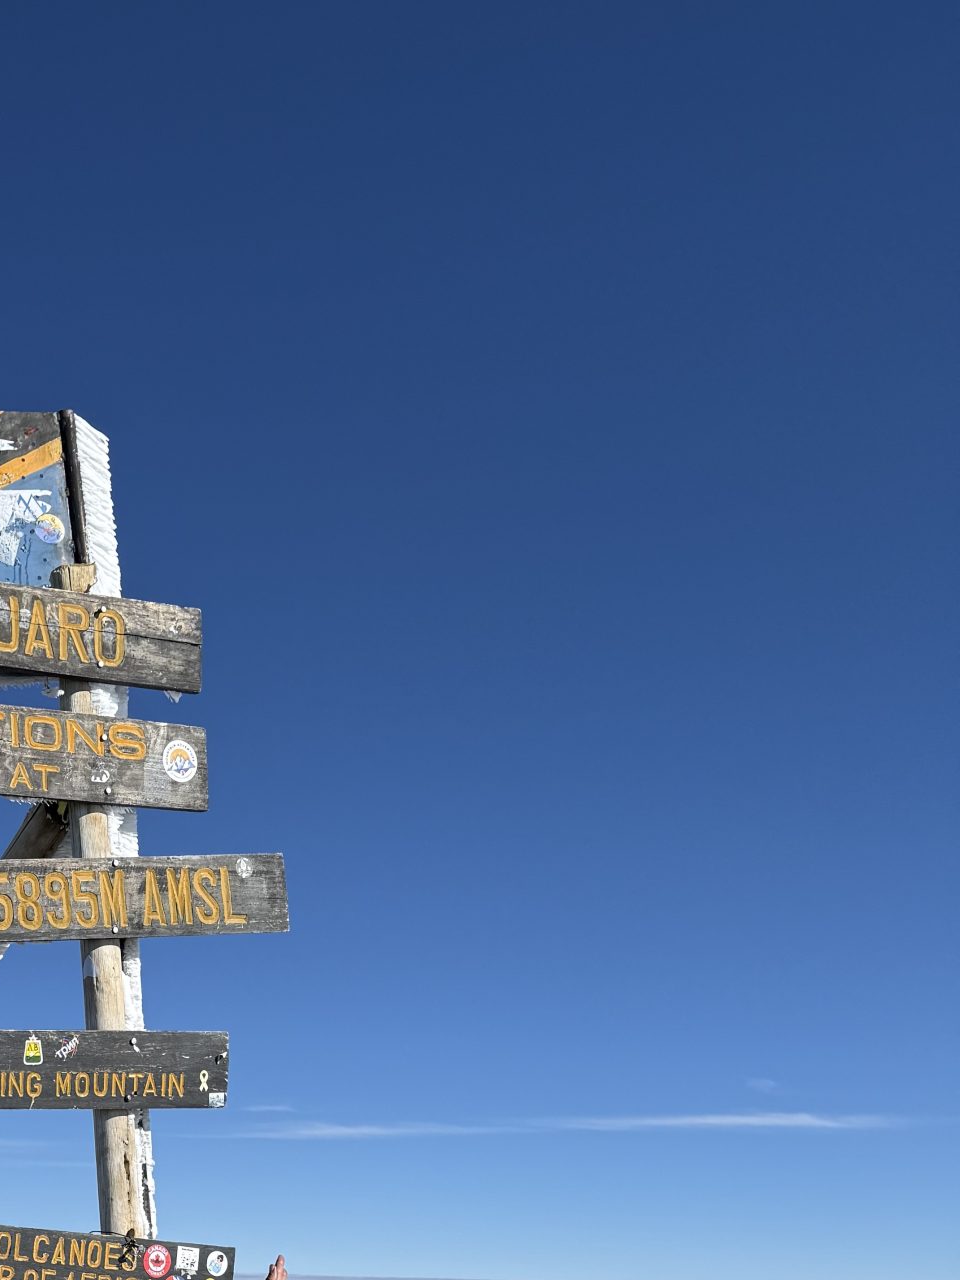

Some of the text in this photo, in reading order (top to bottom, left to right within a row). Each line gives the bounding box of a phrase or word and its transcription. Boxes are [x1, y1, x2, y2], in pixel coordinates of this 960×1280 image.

[9, 761, 61, 792] AT
[142, 865, 248, 926] AMSL
[55, 1071, 186, 1098] MOUNTAIN
